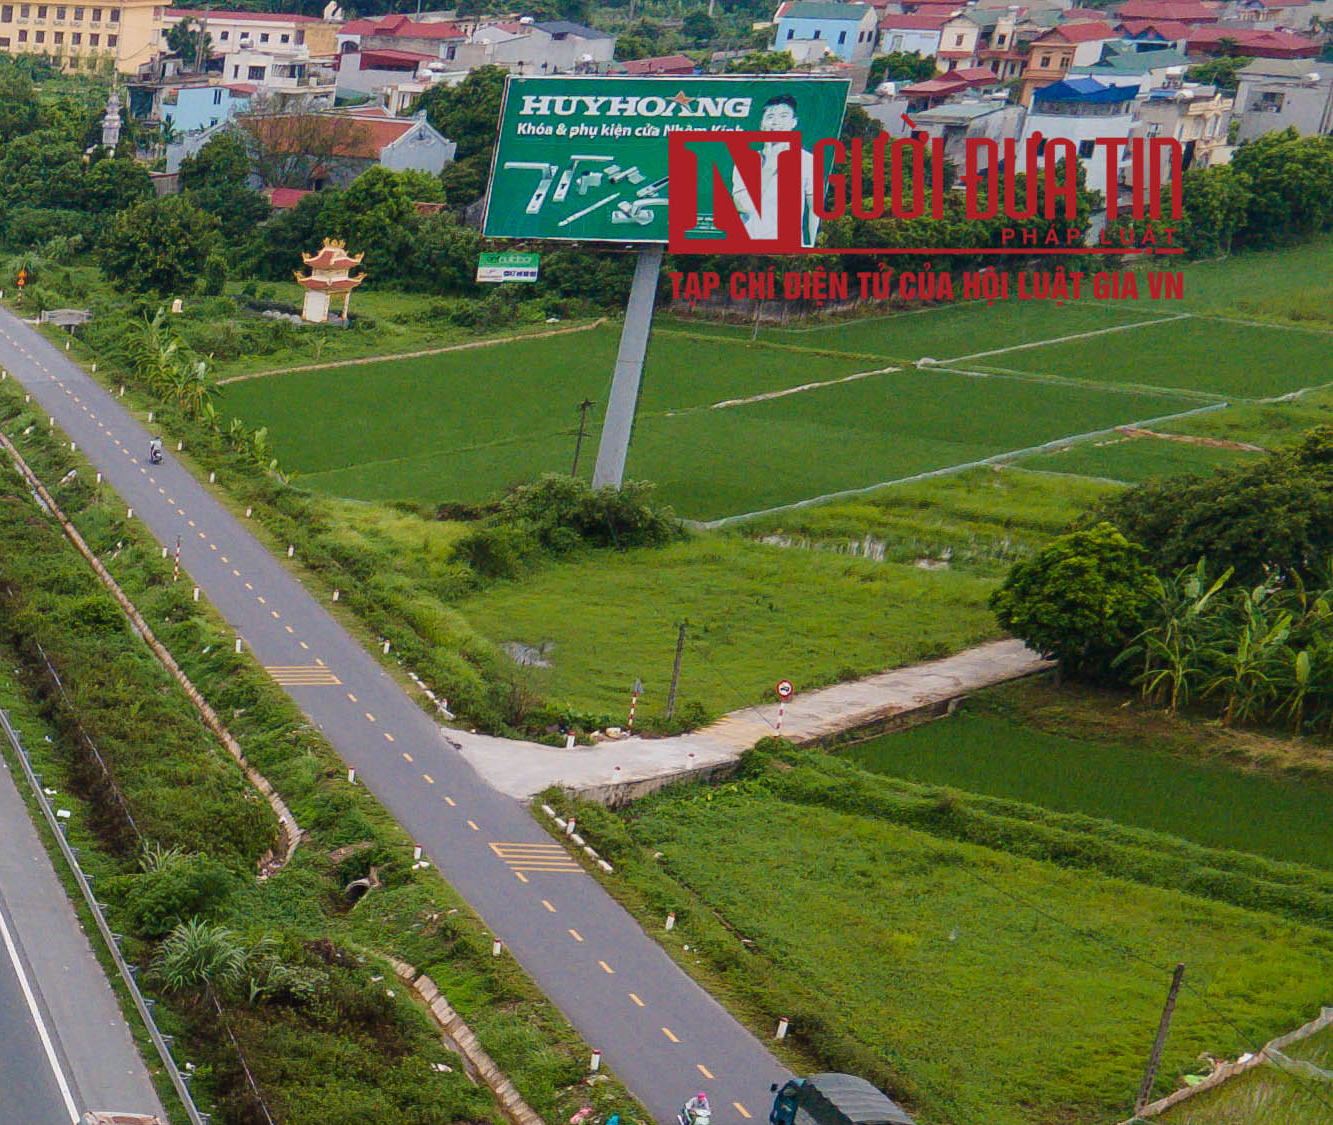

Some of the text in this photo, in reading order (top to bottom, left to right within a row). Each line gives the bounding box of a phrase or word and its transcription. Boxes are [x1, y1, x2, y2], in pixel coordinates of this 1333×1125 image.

[519, 91, 752, 117] HUYHOANG
[517, 122, 552, 136] Khóa
[556, 123, 568, 136] &
[569, 122, 598, 139] phụ
[601, 123, 632, 139] kiện
[635, 123, 660, 137] cửa
